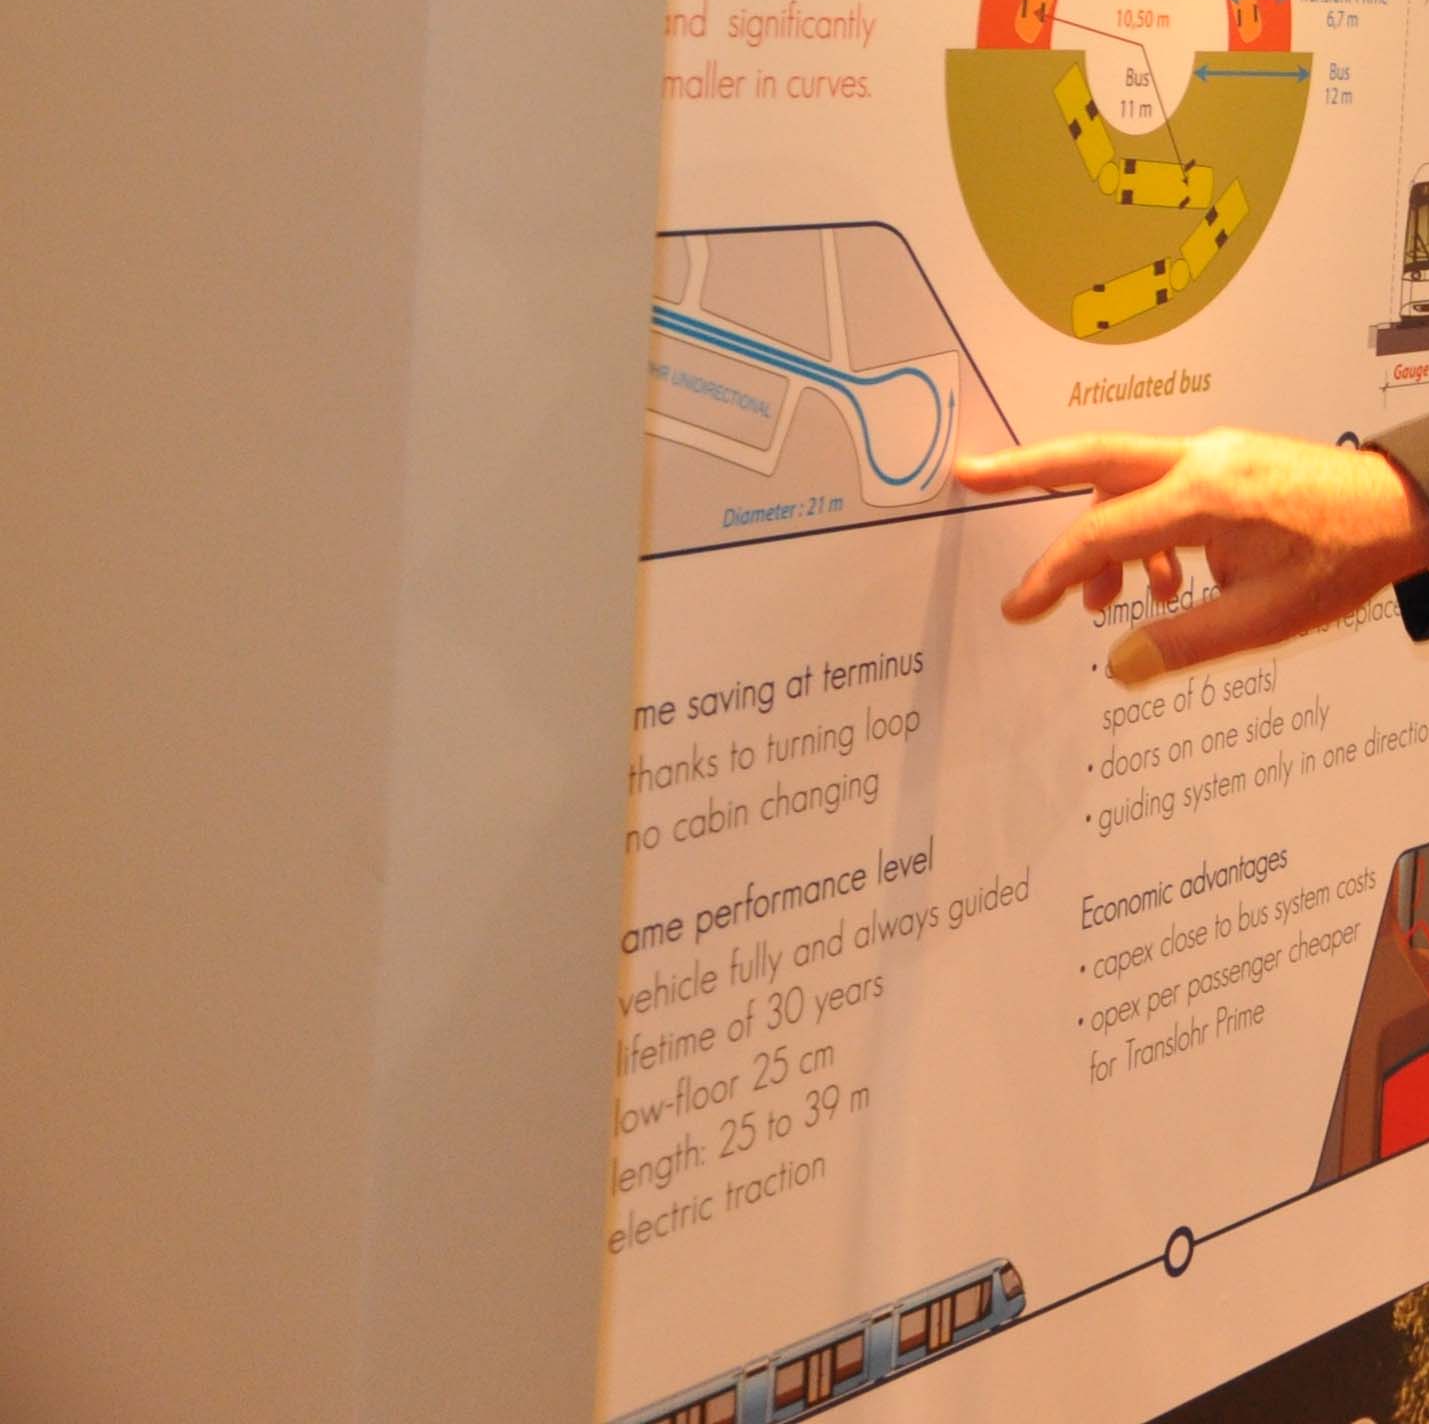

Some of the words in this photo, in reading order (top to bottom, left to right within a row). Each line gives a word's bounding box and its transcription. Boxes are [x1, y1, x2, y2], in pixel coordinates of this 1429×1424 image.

[727, 0, 877, 48] significantly
[1157, 14, 1170, 27] m
[1326, 10, 1343, 30] 6,7
[1344, 14, 1359, 29] m
[756, 70, 777, 100] in
[786, 75, 873, 100] curves.
[1120, 100, 1134, 118] 11
[1138, 103, 1153, 119] m
[1125, 69, 1150, 88] Bus
[1325, 88, 1338, 105] 12
[1339, 90, 1353, 106] m
[1329, 63, 1350, 81] Bus
[1068, 369, 1177, 408] Articulated
[1179, 368, 1212, 394] bus
[1393, 362, 1429, 384] Gauge
[722, 500, 797, 528] Diameter
[807, 496, 826, 516] 21
[827, 496, 844, 512] m
[686, 680, 775, 721] saving
[785, 664, 812, 700] at
[823, 650, 924, 693] terminus
[1103, 696, 1165, 736] space
[1174, 677, 1194, 714] of
[1201, 673, 1215, 707] 6
[628, 742, 719, 795] thanks
[730, 741, 755, 773] to
[768, 724, 855, 765] turning
[865, 706, 921, 742] loop
[1101, 745, 1161, 780] doors
[1168, 737, 1193, 764] on
[1201, 724, 1239, 755] one
[1246, 706, 1284, 743] side
[1291, 694, 1330, 732] only
[624, 824, 661, 854] no
[673, 796, 748, 843] cabin
[760, 772, 879, 821] changing
[1098, 786, 1176, 838] guiding
[1183, 771, 1247, 812] system
[1253, 749, 1293, 788] only
[1300, 751, 1316, 776] in
[1322, 741, 1357, 769] one
[695, 866, 867, 945] performance
[877, 834, 935, 885] level
[1081, 880, 1173, 930] Economic
[1179, 847, 1288, 903] advantages
[1093, 941, 1154, 984] capex
[1160, 921, 1208, 958] close
[1215, 913, 1232, 940] to
[1238, 900, 1269, 933] bus
[1274, 884, 1330, 921] system
[1335, 866, 1378, 901] costs
[617, 959, 718, 1019] vehicle
[730, 941, 784, 986] fully
[793, 918, 844, 968] and
[854, 902, 940, 950] always
[948, 866, 1031, 930] guided
[1090, 997, 1142, 1035] opex
[1147, 982, 1181, 1022] per
[1187, 947, 1283, 1006] passenger
[1288, 921, 1362, 964] cheaper
[617, 1025, 716, 1078] lifetime
[727, 998, 756, 1043] of
[767, 986, 804, 1032] 30
[814, 974, 885, 1025] years
[1089, 1049, 1118, 1086] for
[1125, 1014, 1209, 1072] Translohr
[1215, 999, 1265, 1040] Prime
[613, 1074, 740, 1138] low-floor
[752, 1045, 790, 1092] 25
[799, 1043, 835, 1076] cm
[611, 1133, 707, 1198] length:
[719, 1111, 757, 1160] 25
[768, 1112, 792, 1142] to
[804, 1082, 840, 1128] 39
[850, 1083, 870, 1111] m
[607, 1196, 714, 1256] electric
[725, 1155, 826, 1213] traction
